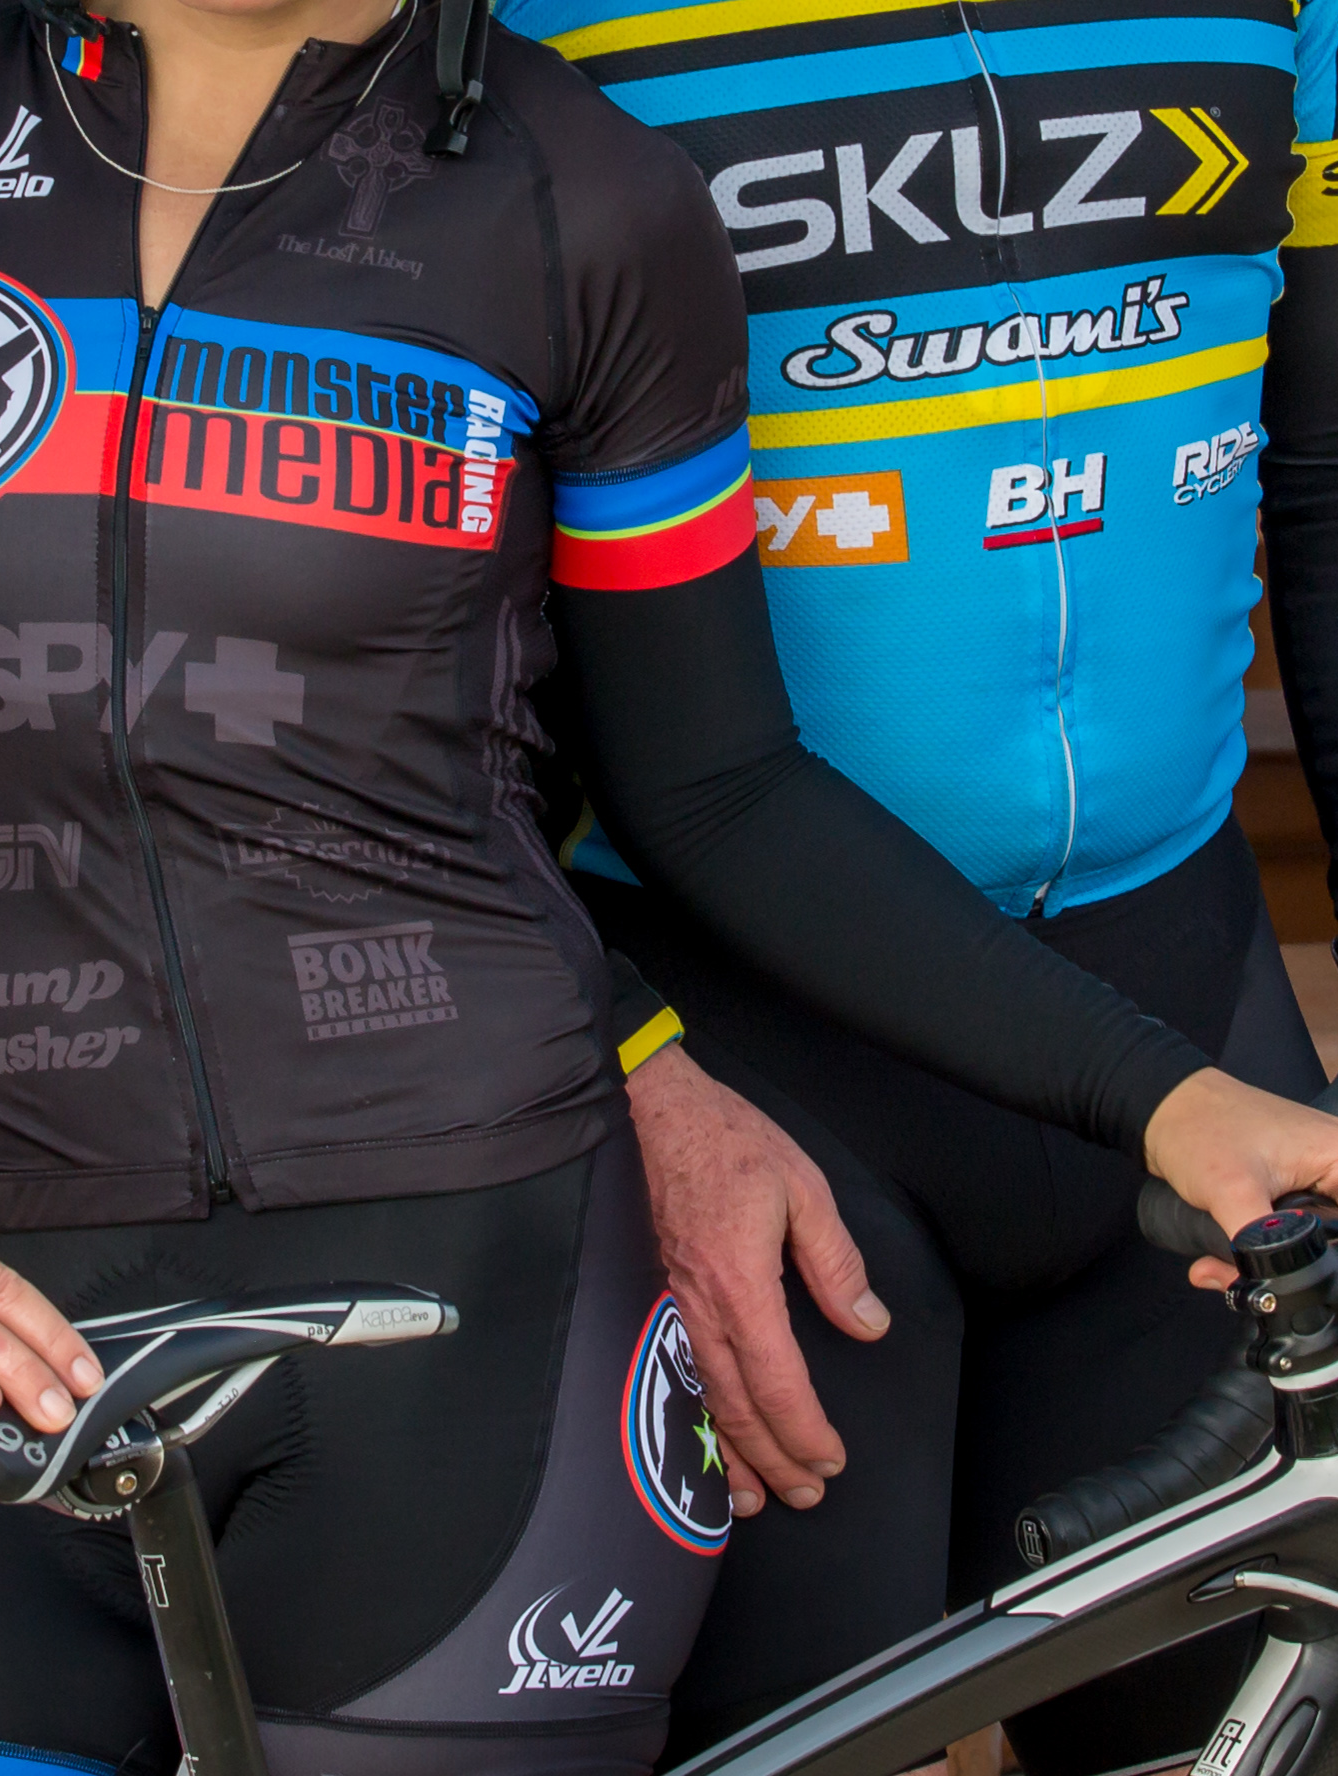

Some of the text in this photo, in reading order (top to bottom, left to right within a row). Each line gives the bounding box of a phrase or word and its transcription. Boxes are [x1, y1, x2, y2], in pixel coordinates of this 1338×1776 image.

[708, 108, 1147, 273] SKLZ
[277, 234, 311, 254] The
[359, 246, 423, 280] Abbey
[782, 274, 1189, 391] Swami's
[166, 335, 466, 445] monster
[461, 387, 507, 535] RACING
[1172, 420, 1259, 488] RIDE
[1173, 454, 1246, 505] CYCLERY
[985, 453, 1107, 529] BH
[290, 932, 445, 992] BONK
[301, 975, 453, 1023] BREAKER
[360, 1305, 429, 1331] kappa evo
